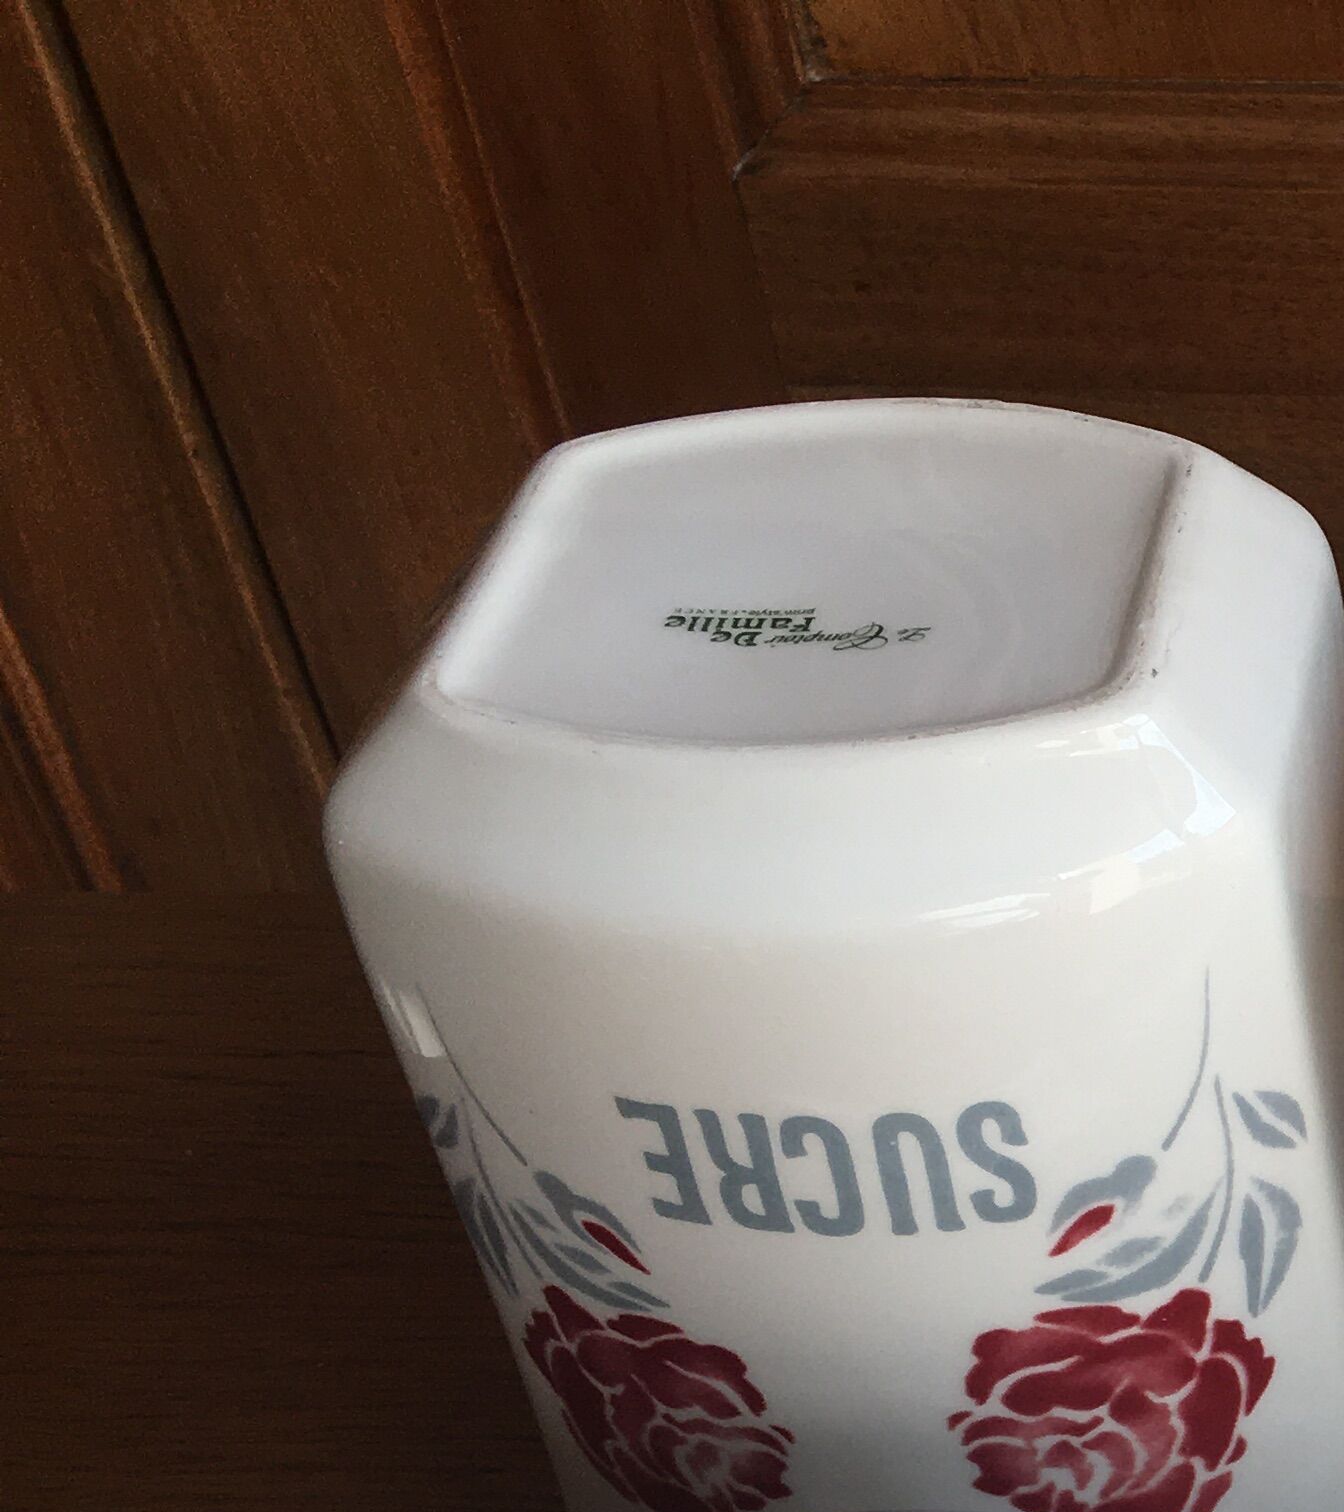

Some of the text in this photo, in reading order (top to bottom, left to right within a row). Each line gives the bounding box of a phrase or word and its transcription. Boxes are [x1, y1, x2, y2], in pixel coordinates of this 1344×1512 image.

[664, 615, 816, 633] Famille
[710, 621, 931, 651] Le Comptoir De
[614, 1096, 1038, 1238] SUCRE
